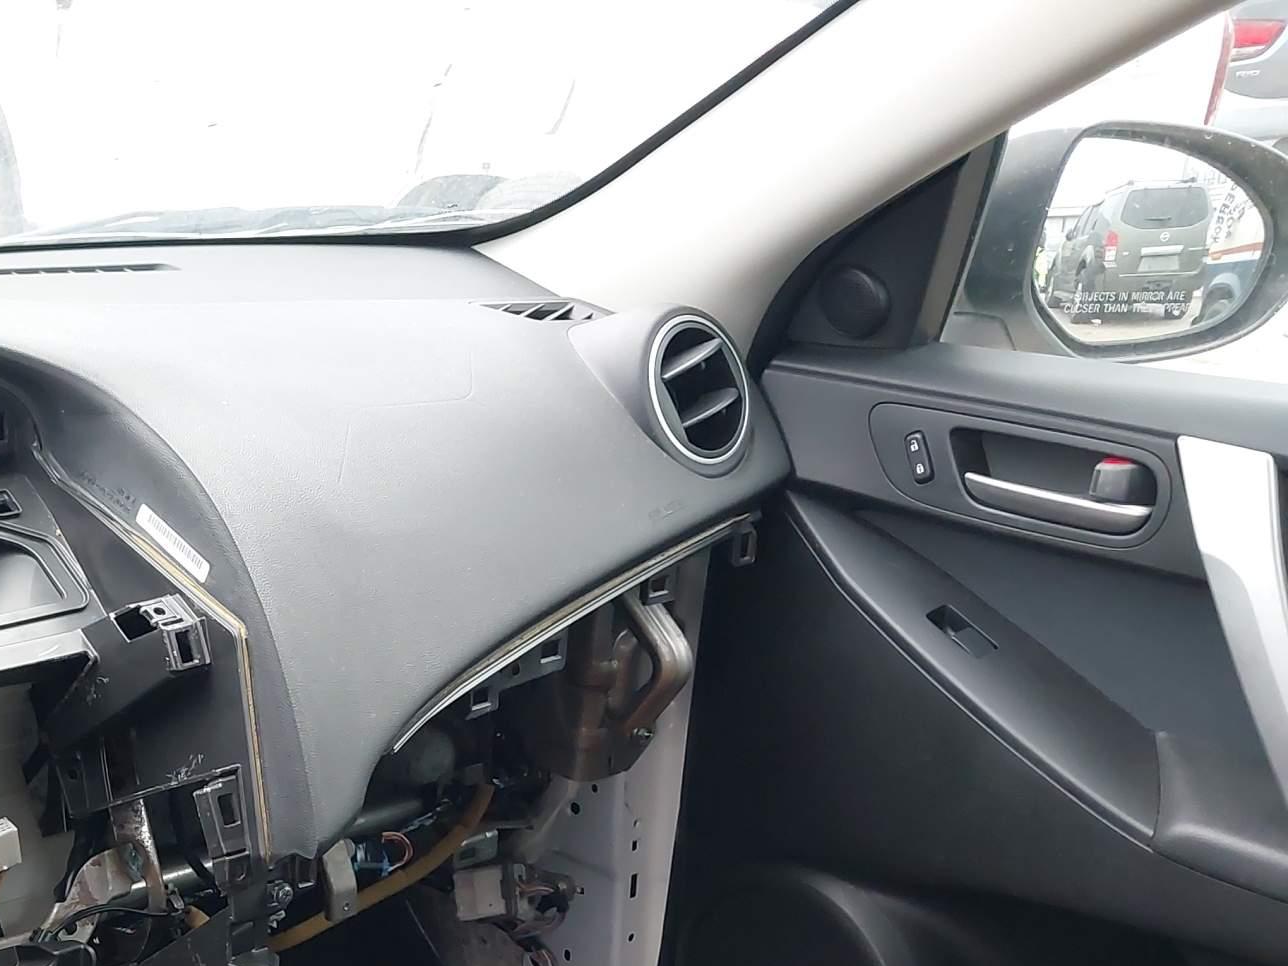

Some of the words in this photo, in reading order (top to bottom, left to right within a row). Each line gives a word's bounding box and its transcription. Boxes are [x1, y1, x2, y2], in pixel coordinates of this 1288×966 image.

[1118, 291, 1128, 301] IN
[1131, 291, 1165, 301] MIRROR
[1167, 290, 1186, 301] ARE
[1063, 303, 1100, 313] CLOSER
[1103, 303, 1129, 313] THAN
